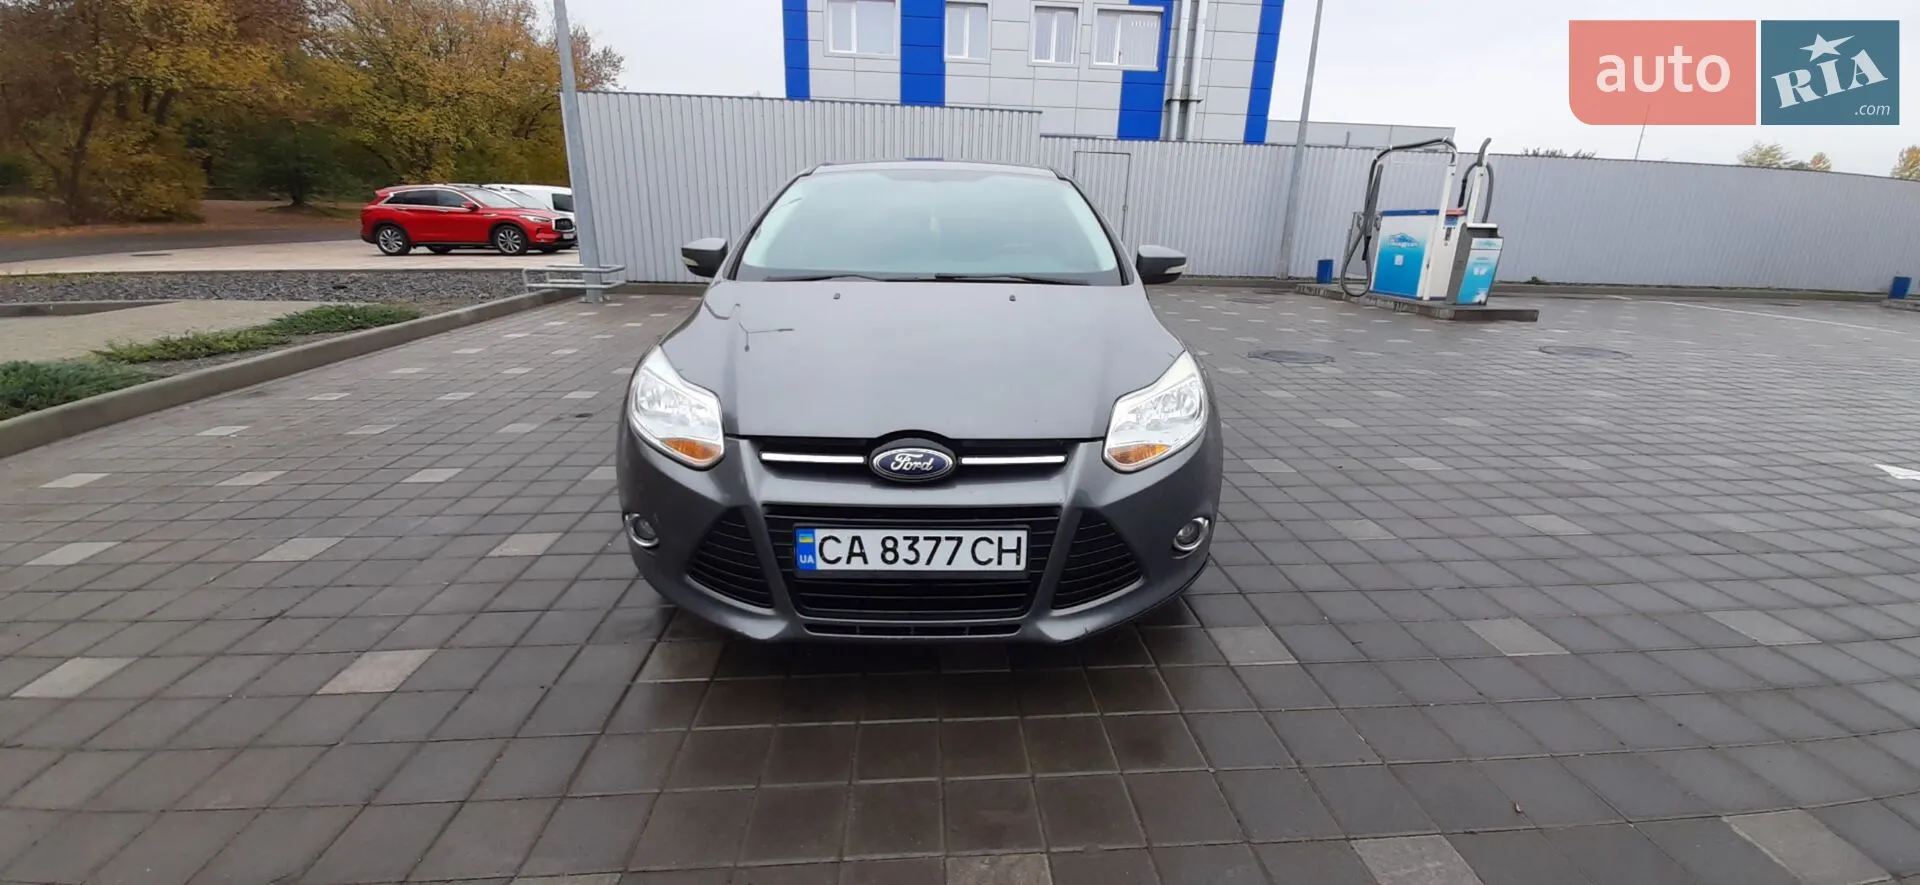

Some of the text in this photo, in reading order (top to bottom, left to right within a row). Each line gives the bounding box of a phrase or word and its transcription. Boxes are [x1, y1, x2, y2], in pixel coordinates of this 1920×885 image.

[890, 452, 935, 472] Ford
[799, 554, 815, 564] UA
[818, 535, 1022, 566] CA 8377 CH
